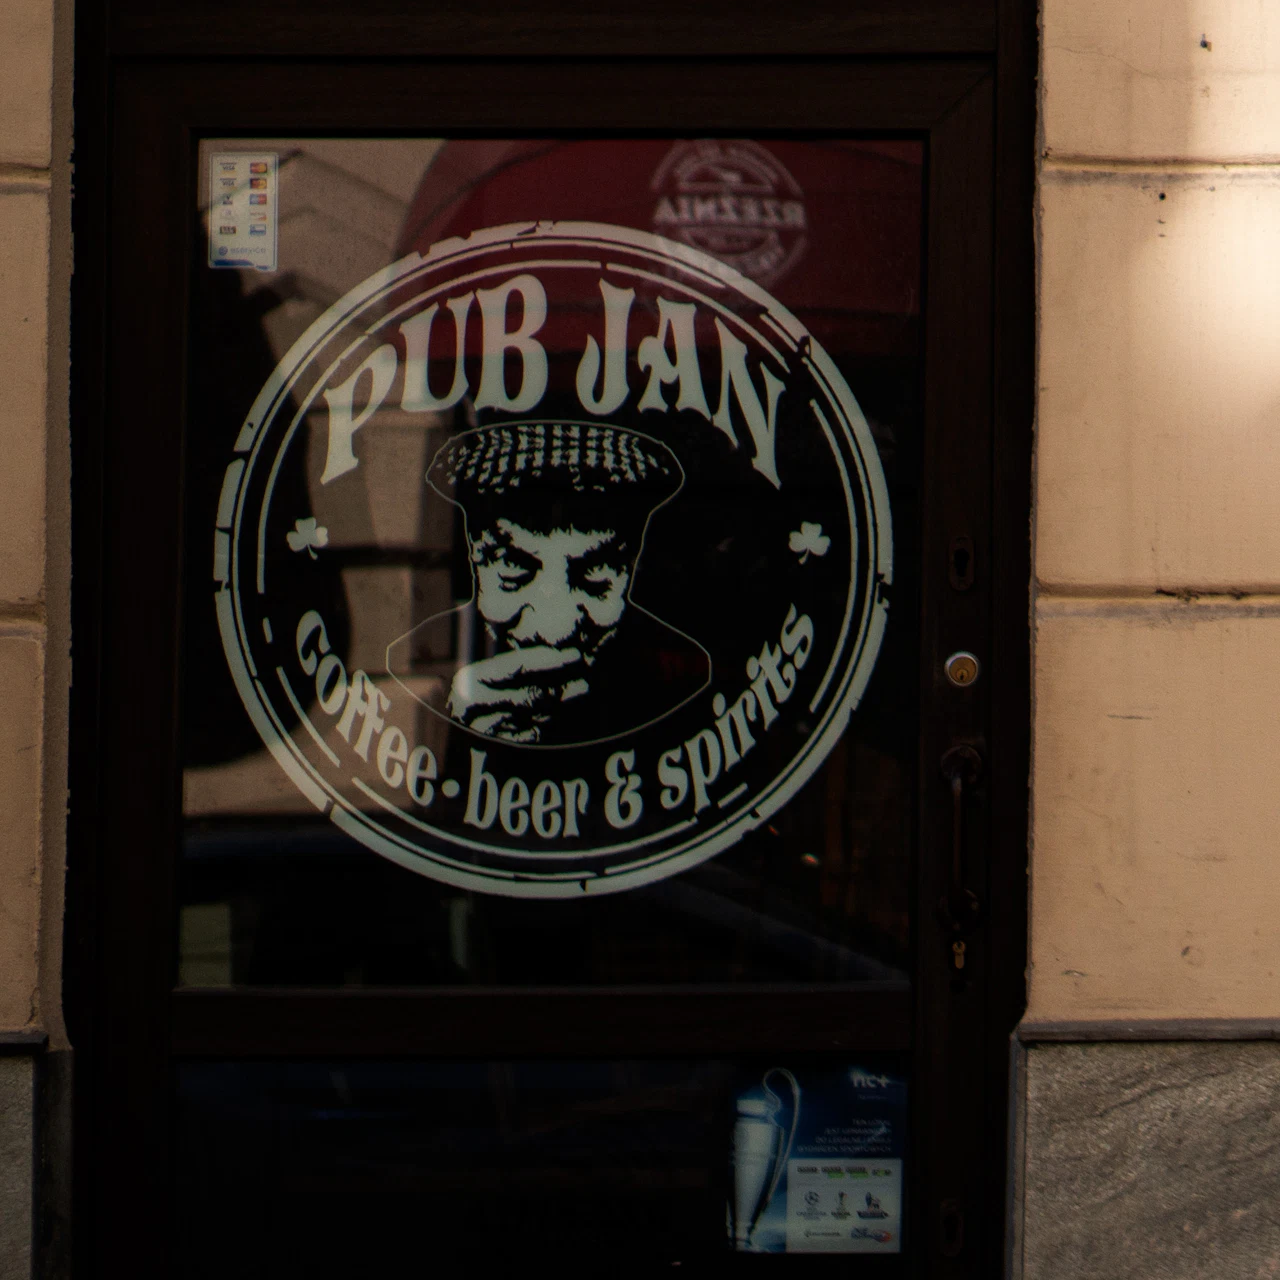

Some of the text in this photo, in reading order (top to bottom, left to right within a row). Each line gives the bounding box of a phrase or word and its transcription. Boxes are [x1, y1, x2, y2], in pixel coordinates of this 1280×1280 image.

[320, 273, 787, 490] PUB JAN
[295, 604, 815, 839] coffee beer & spirits
